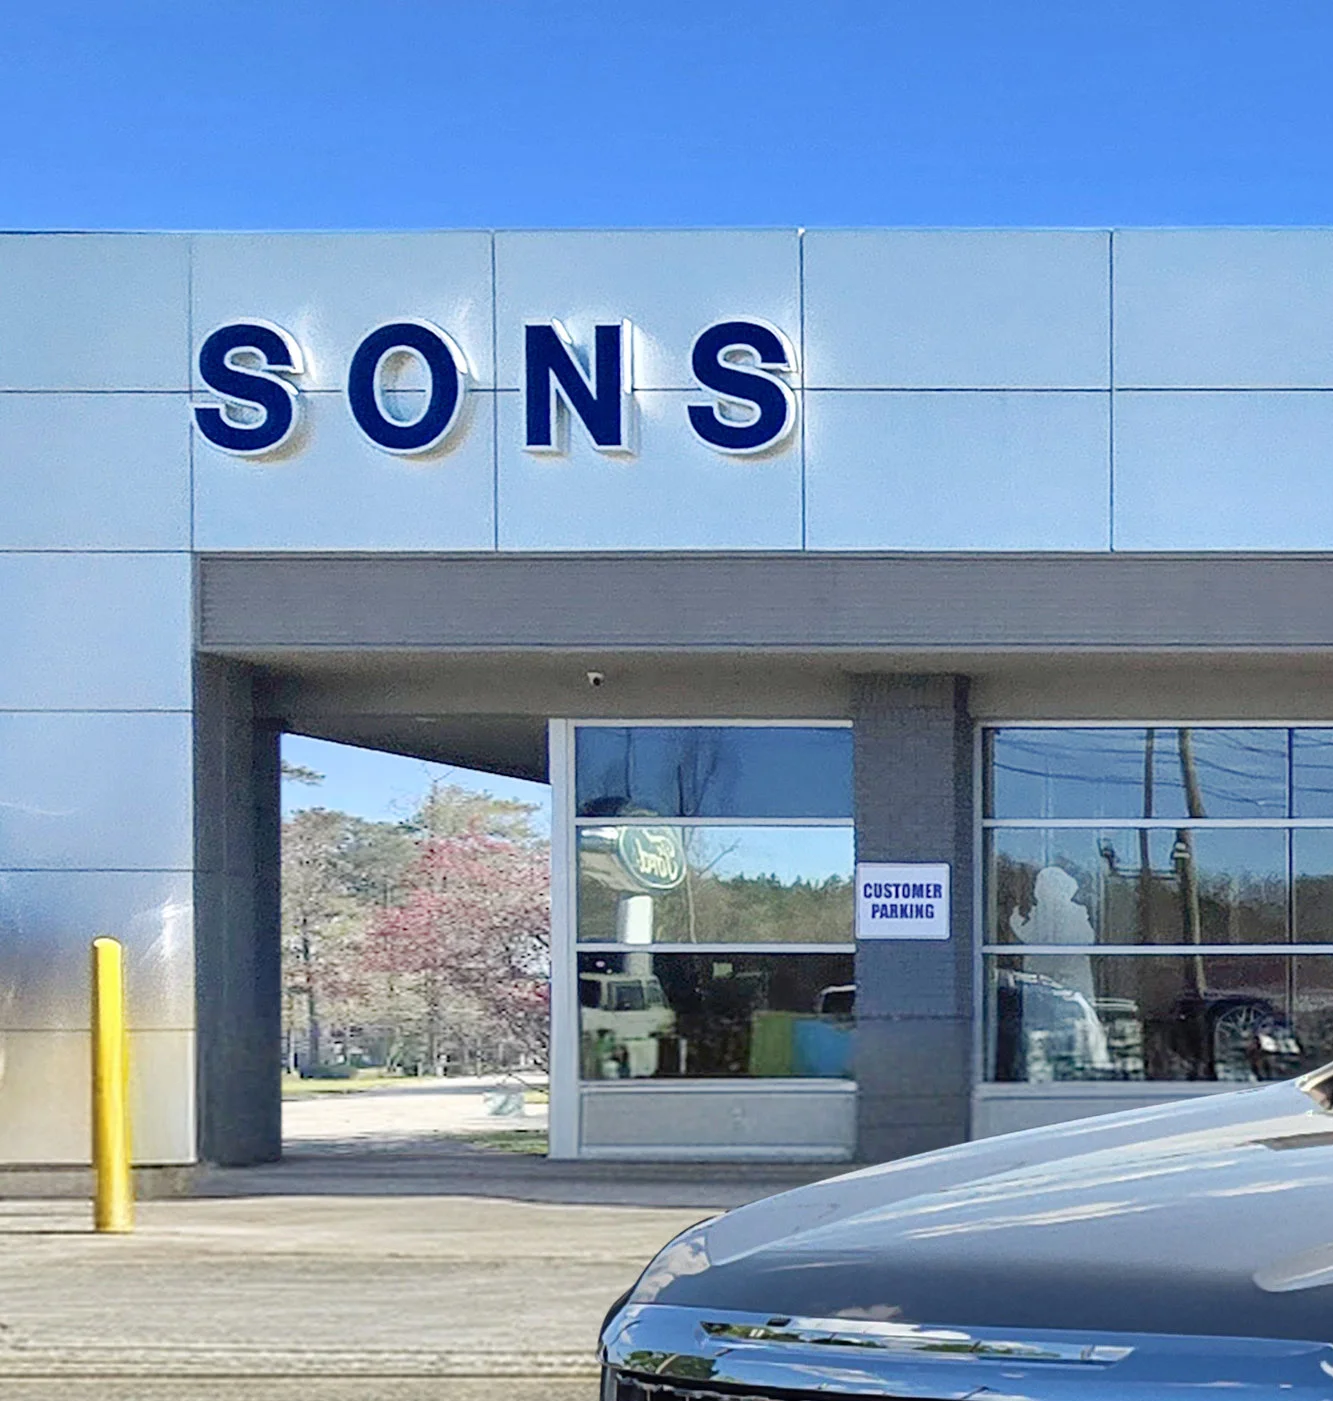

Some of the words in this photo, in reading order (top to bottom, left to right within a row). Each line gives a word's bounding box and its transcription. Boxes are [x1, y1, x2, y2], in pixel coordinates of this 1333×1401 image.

[193, 319, 796, 455] SONS
[863, 883, 942, 899] CUSTOMER
[871, 903, 935, 919] PARKING
